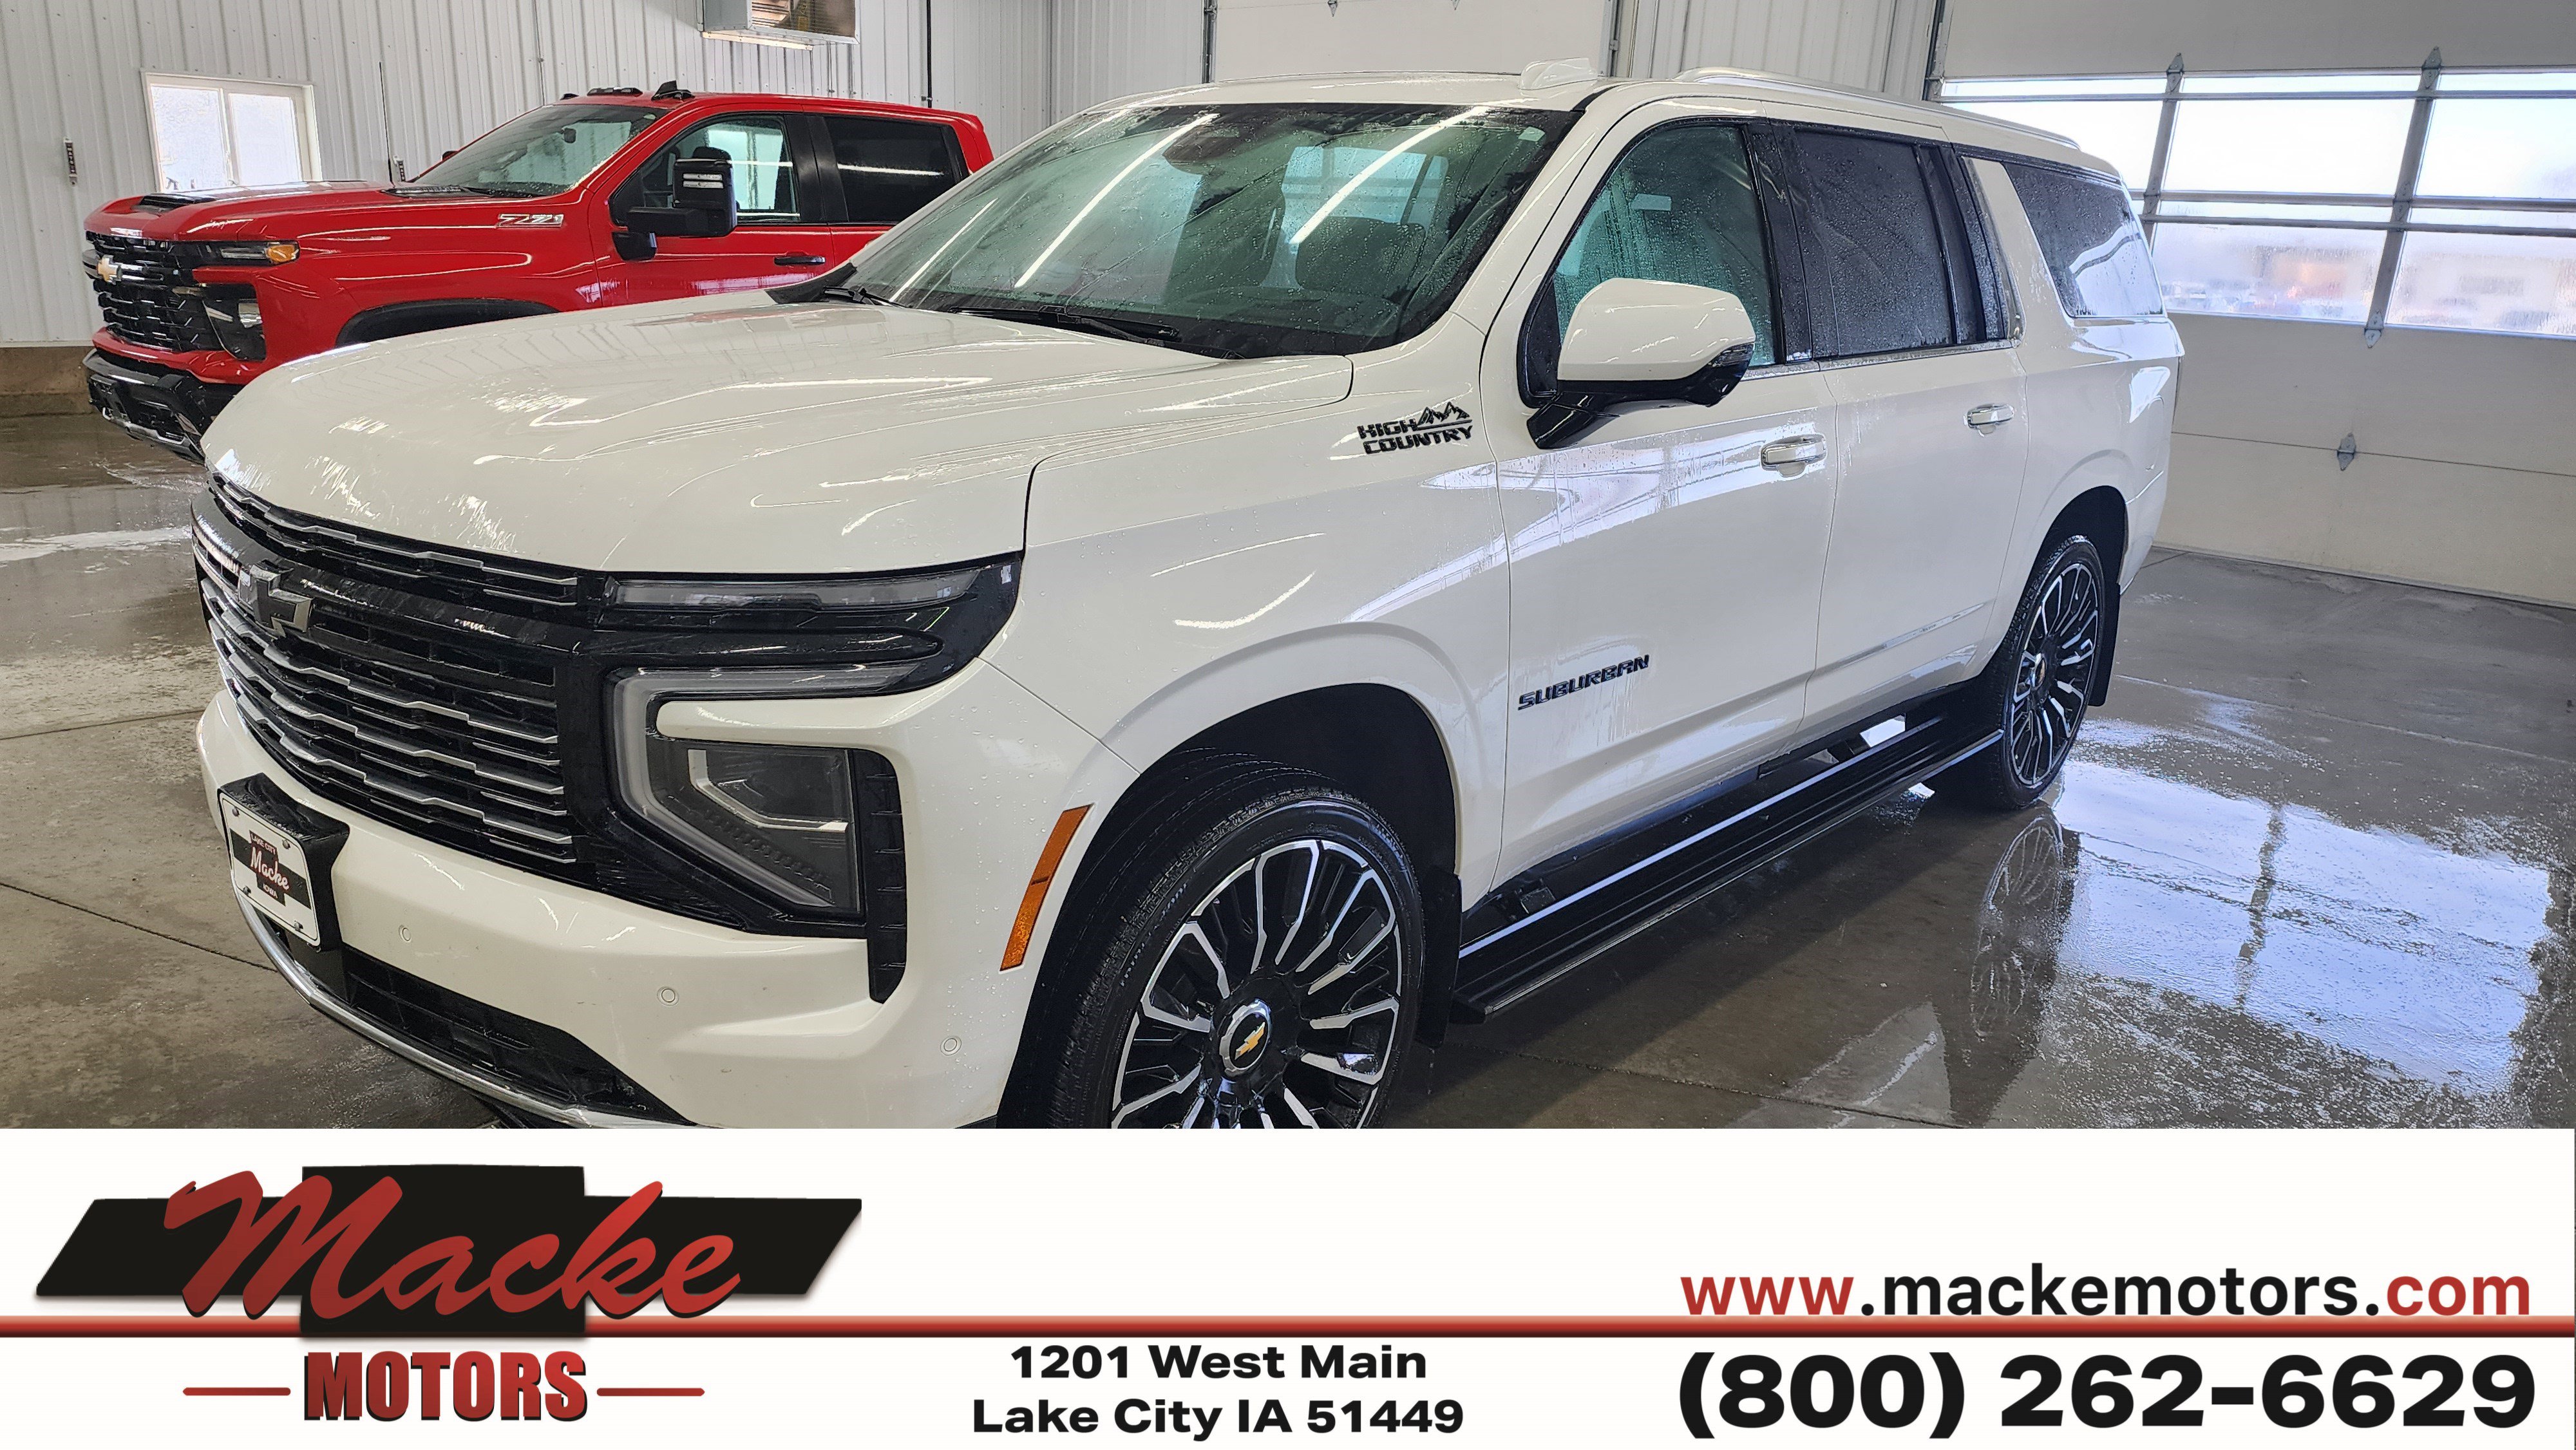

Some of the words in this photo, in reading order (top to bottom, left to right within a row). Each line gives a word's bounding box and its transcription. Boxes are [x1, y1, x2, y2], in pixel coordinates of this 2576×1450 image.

[1357, 418, 1418, 439] HIGH
[1363, 425, 1473, 454] COUNTRY
[1518, 654, 1649, 710] SUBURBAN
[251, 833, 265, 848] LAKE
[265, 843, 276, 855] CITY
[250, 846, 290, 890] Macke
